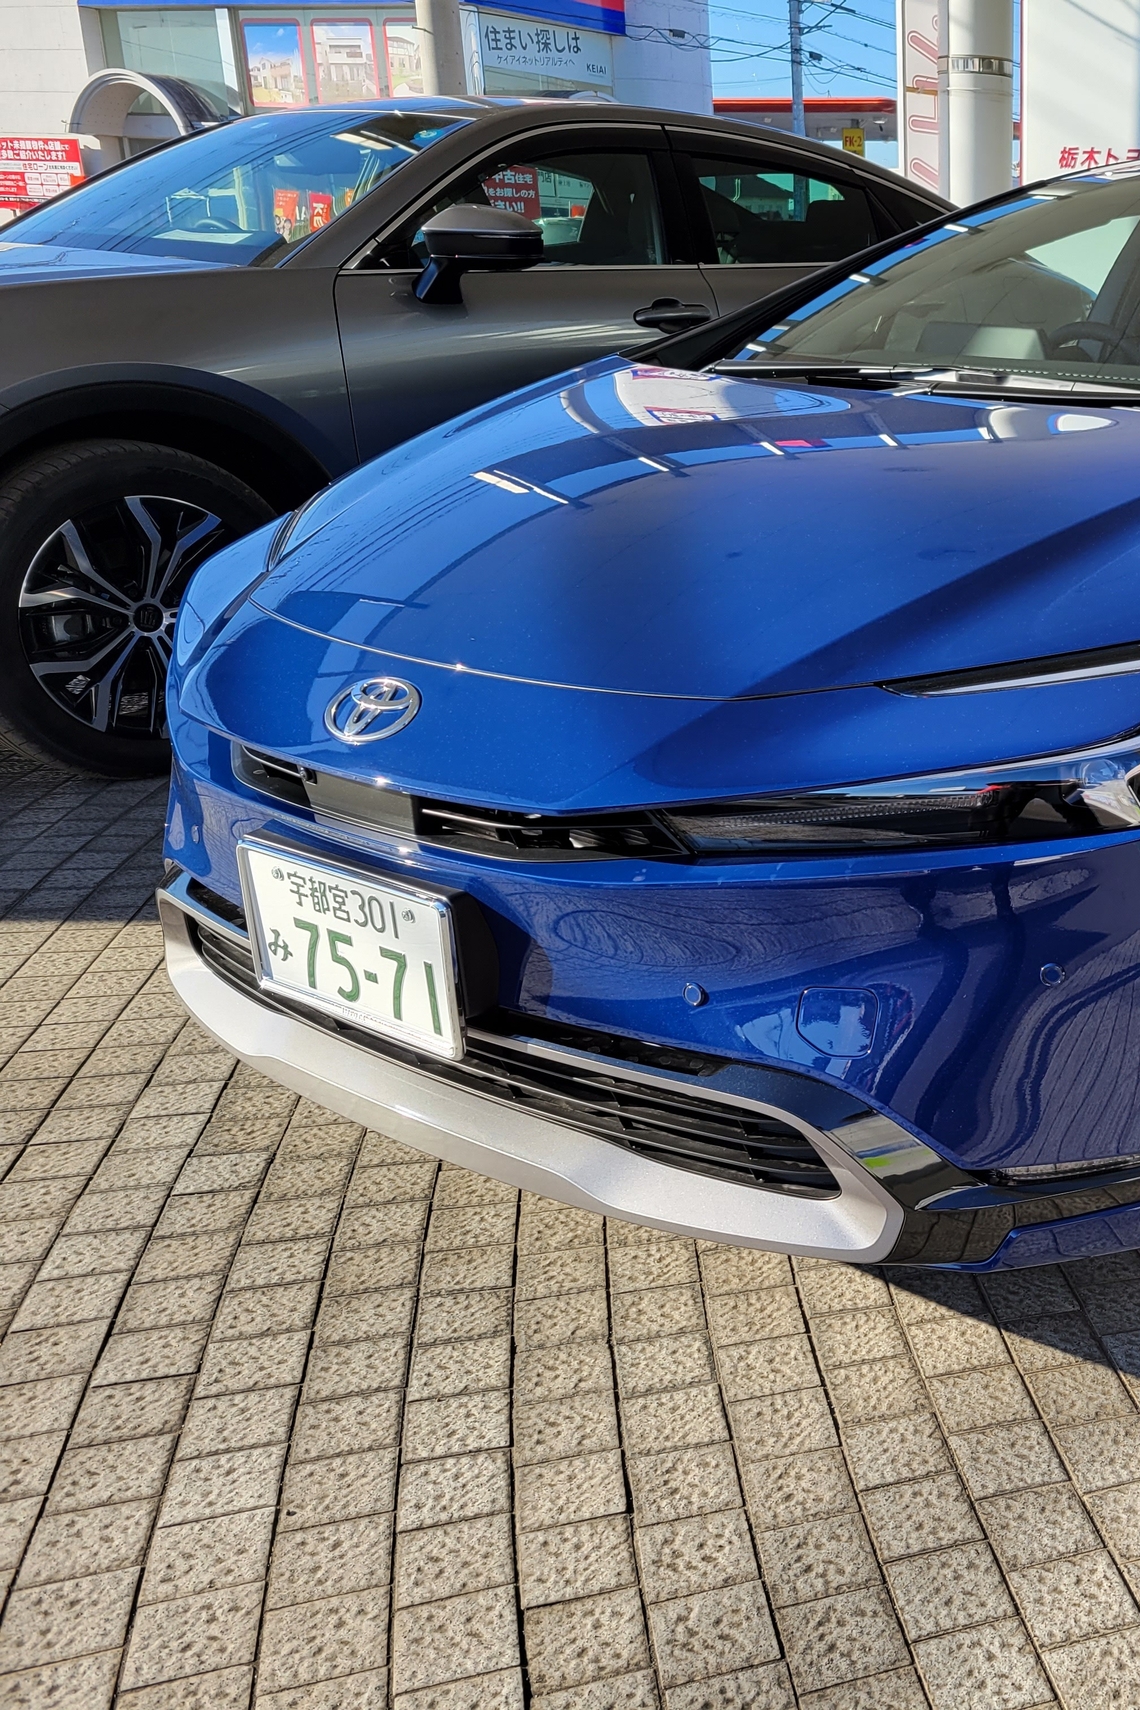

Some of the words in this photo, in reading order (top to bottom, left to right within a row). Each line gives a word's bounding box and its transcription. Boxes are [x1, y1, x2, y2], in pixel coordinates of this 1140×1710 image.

[485, 25, 582, 54] 住まい探しは
[496, 54, 576, 67] ケイアイネットリアルティへ
[586, 62, 607, 75] KEIAI
[287, 871, 400, 940] 宇都宮301
[267, 927, 294, 962] み
[293, 916, 443, 1037] 75-71
